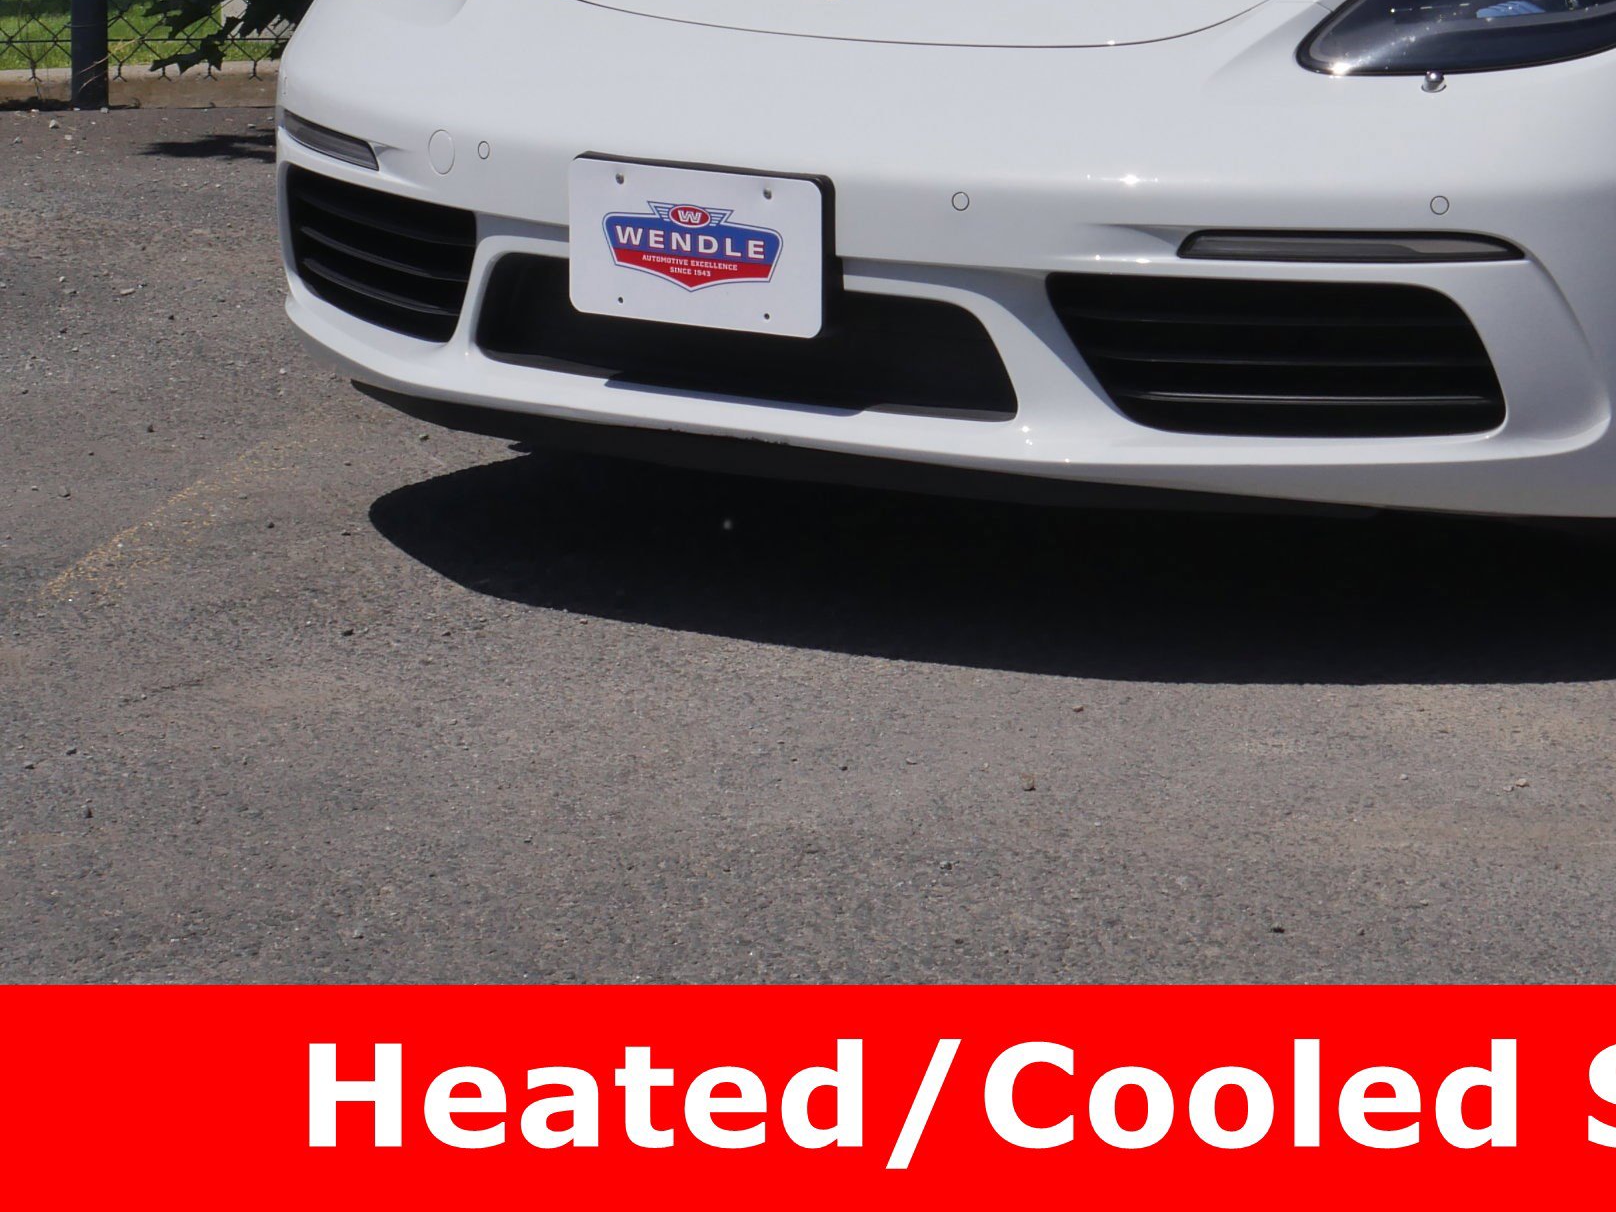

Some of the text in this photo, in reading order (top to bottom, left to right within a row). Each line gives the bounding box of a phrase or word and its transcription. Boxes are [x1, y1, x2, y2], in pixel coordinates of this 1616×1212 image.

[615, 225, 765, 259] WENDLE
[642, 254, 738, 271] AUTOMOTIVE EXCELLENCE
[669, 266, 692, 275] SINCE
